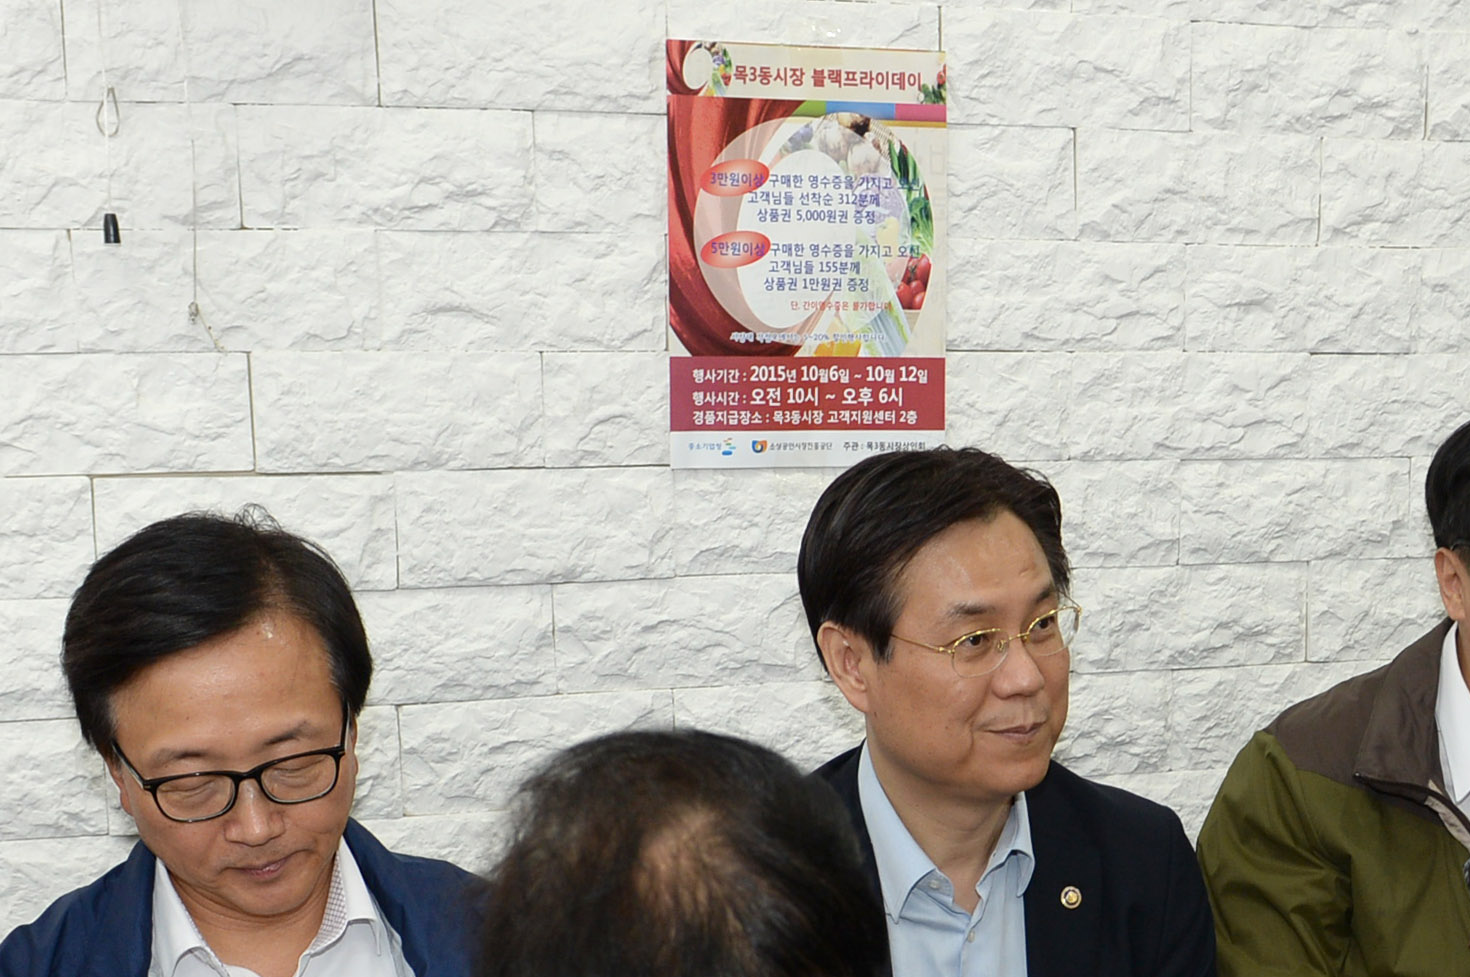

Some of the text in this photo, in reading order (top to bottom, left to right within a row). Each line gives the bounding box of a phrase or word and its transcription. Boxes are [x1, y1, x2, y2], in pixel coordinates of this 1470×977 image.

[733, 65, 922, 90] 목3동시장 블랙프라이데이
[710, 172, 765, 188] 3만원이상
[769, 172, 803, 188] 구매한
[808, 174, 854, 189] 영수증을
[858, 175, 894, 190] 가지고
[747, 191, 881, 208] 고객님들 선착순 312분께
[757, 208, 876, 225] 상품권 5,000원권 증정
[711, 242, 921, 259] 5만원이상 구매한 영수증을 가지고 오신
[768, 260, 862, 276] 고객님들 155분께
[764, 277, 870, 293] 상품권 1만원권 증정
[693, 368, 740, 383] 행사기간
[750, 366, 797, 383] 2015년
[801, 366, 850, 383] 10월6일
[866, 366, 895, 383] 10월
[900, 366, 928, 383] 12일
[693, 391, 740, 407] 행사시간
[750, 387, 781, 407] 오전
[787, 387, 819, 405] 10시
[841, 388, 873, 406] 오후
[879, 387, 903, 406] 6시
[693, 410, 762, 426] 경품지급장소
[773, 410, 823, 425] 목3동시장
[827, 409, 896, 425] 고객지원센터
[900, 409, 918, 424] 2층
[843, 441, 859, 451] 주관
